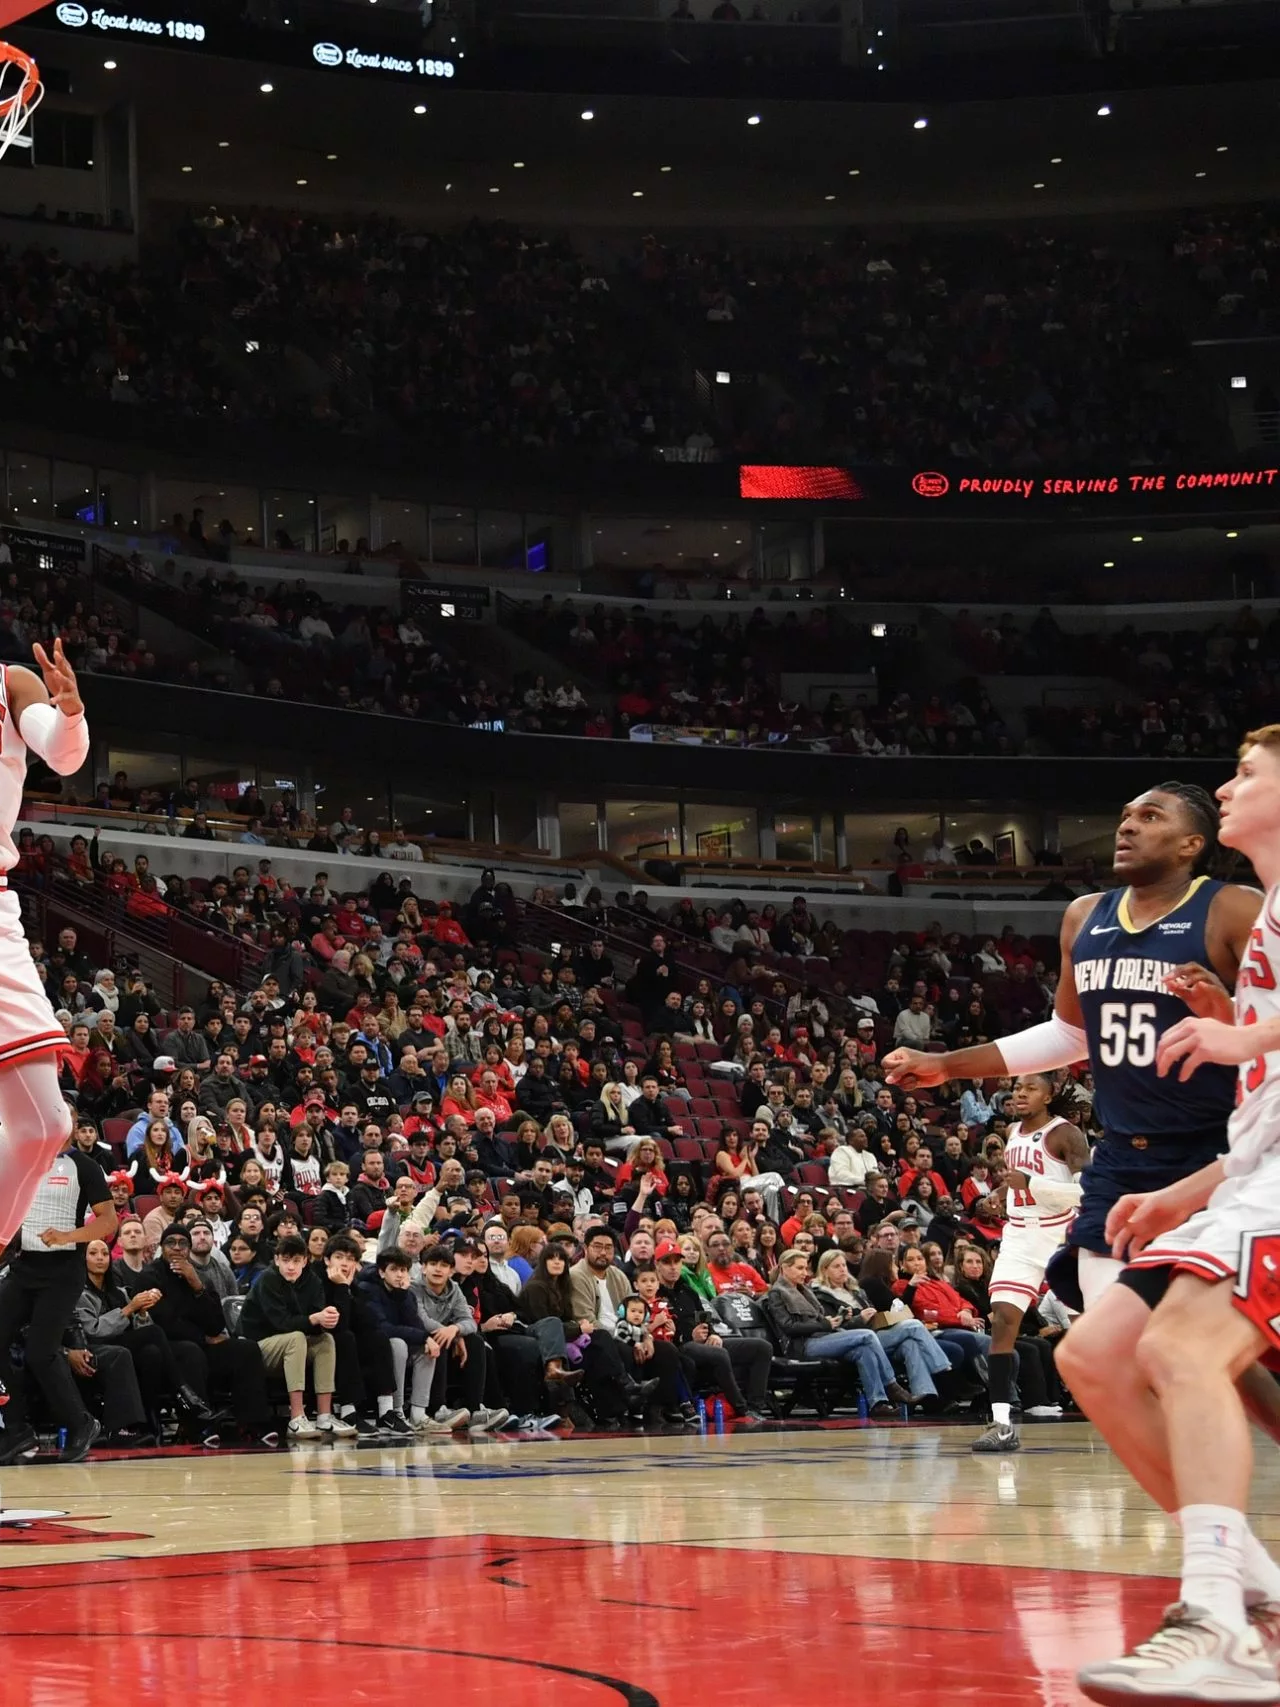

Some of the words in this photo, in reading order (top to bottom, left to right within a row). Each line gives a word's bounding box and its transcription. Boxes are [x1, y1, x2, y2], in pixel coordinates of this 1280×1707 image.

[92, 9, 129, 29] Local
[129, 18, 162, 34] since
[166, 21, 205, 41] 1899
[346, 48, 381, 68] Local
[381, 57, 413, 72] since
[417, 59, 454, 77] 1899
[960, 479, 1033, 497] PROUDLY
[1044, 478, 1118, 493] SERVING
[1130, 476, 1165, 490] THE
[1176, 470, 1278, 489] COMMUNIT
[1158, 922, 1192, 931] NEWAGE
[1074, 958, 1112, 995] NEW
[1100, 1002, 1157, 1068] 55
